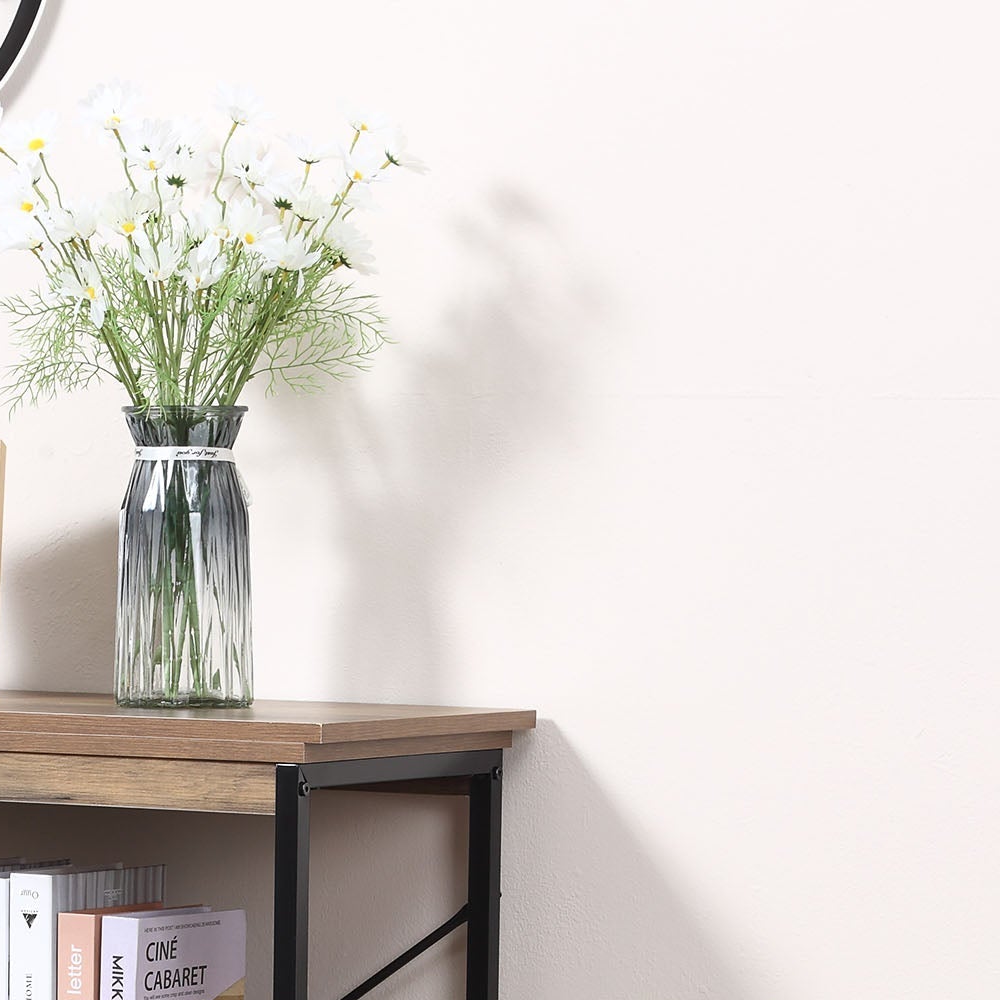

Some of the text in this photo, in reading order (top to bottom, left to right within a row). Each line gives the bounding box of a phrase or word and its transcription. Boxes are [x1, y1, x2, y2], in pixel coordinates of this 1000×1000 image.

[145, 935, 178, 963] CINÉ
[67, 943, 83, 995] letter
[144, 965, 208, 992] CABARET
